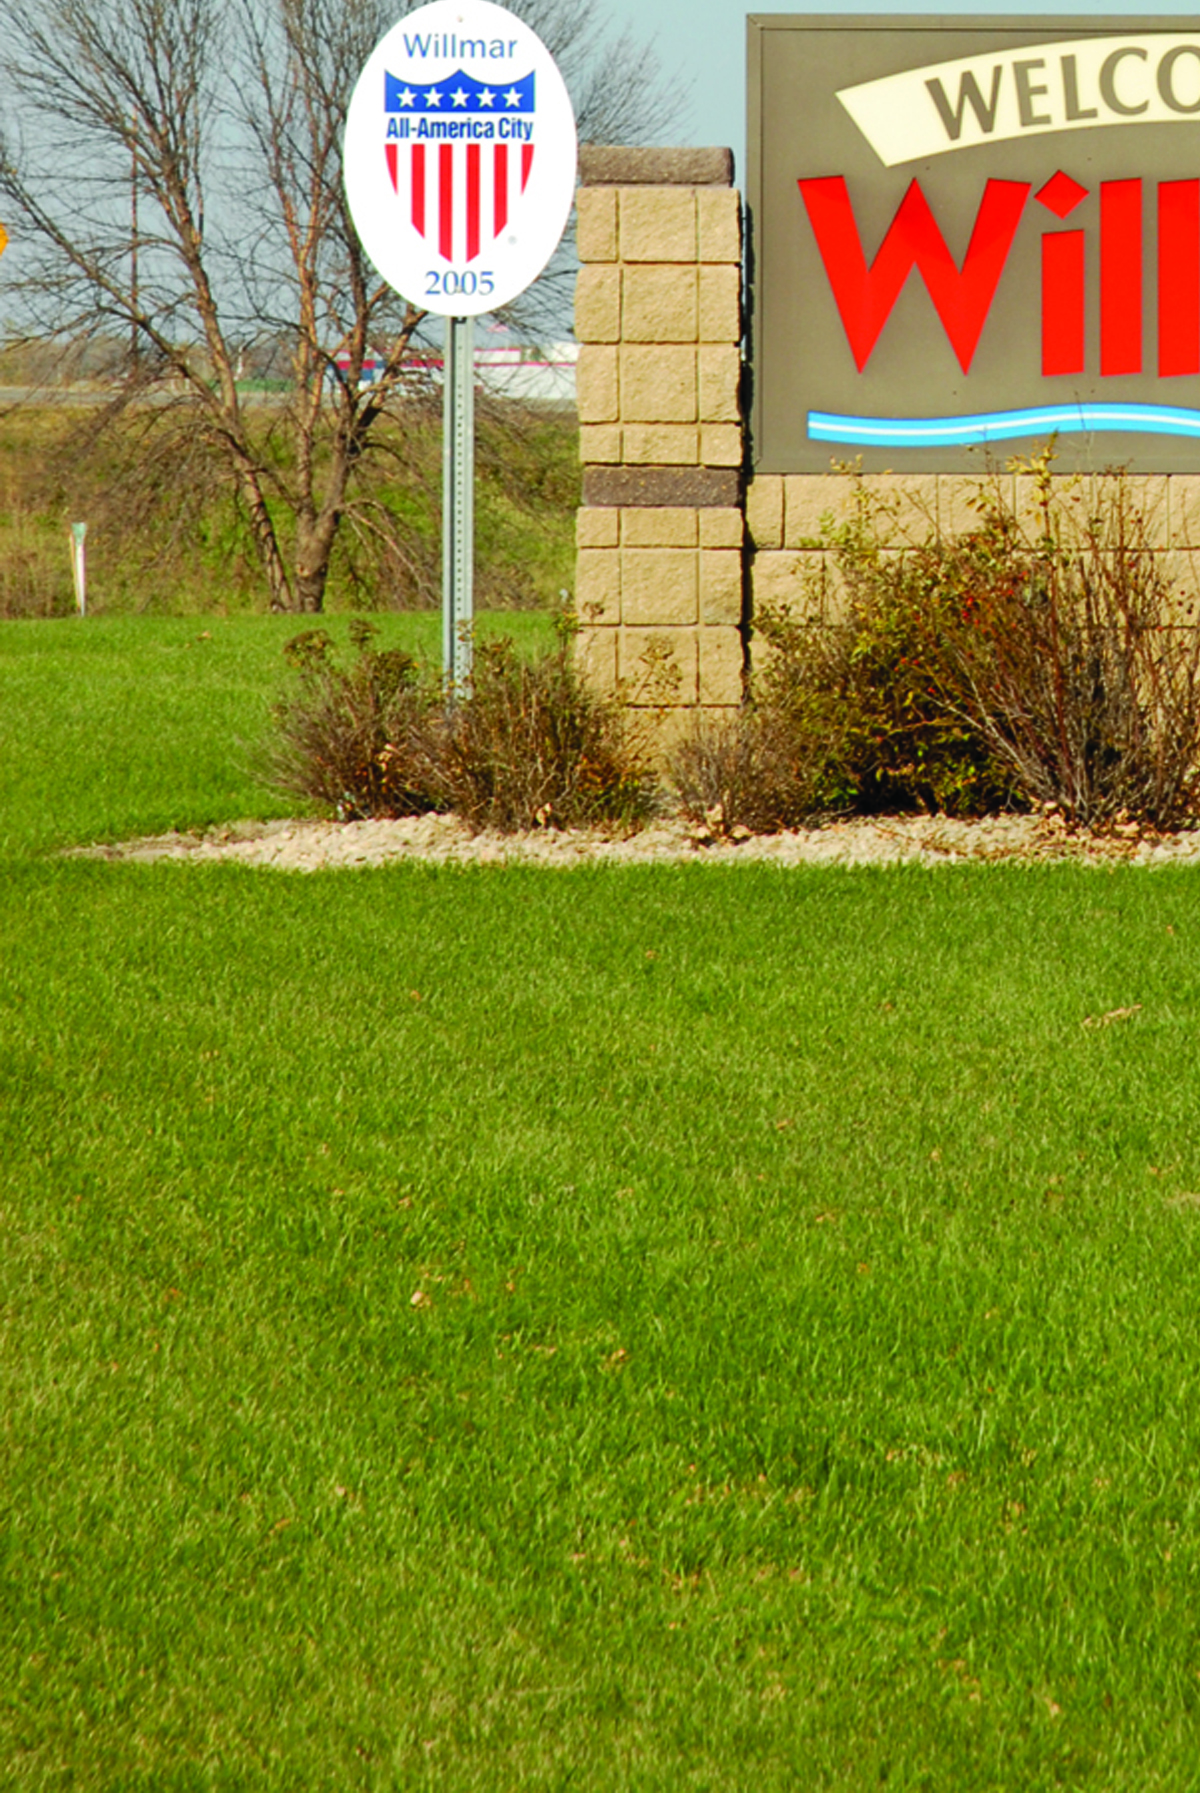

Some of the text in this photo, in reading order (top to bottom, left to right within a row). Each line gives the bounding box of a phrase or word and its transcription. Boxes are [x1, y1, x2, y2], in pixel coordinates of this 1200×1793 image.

[403, 33, 518, 58] Willmar
[386, 117, 534, 141] All-America City
[425, 271, 495, 296] 2005
